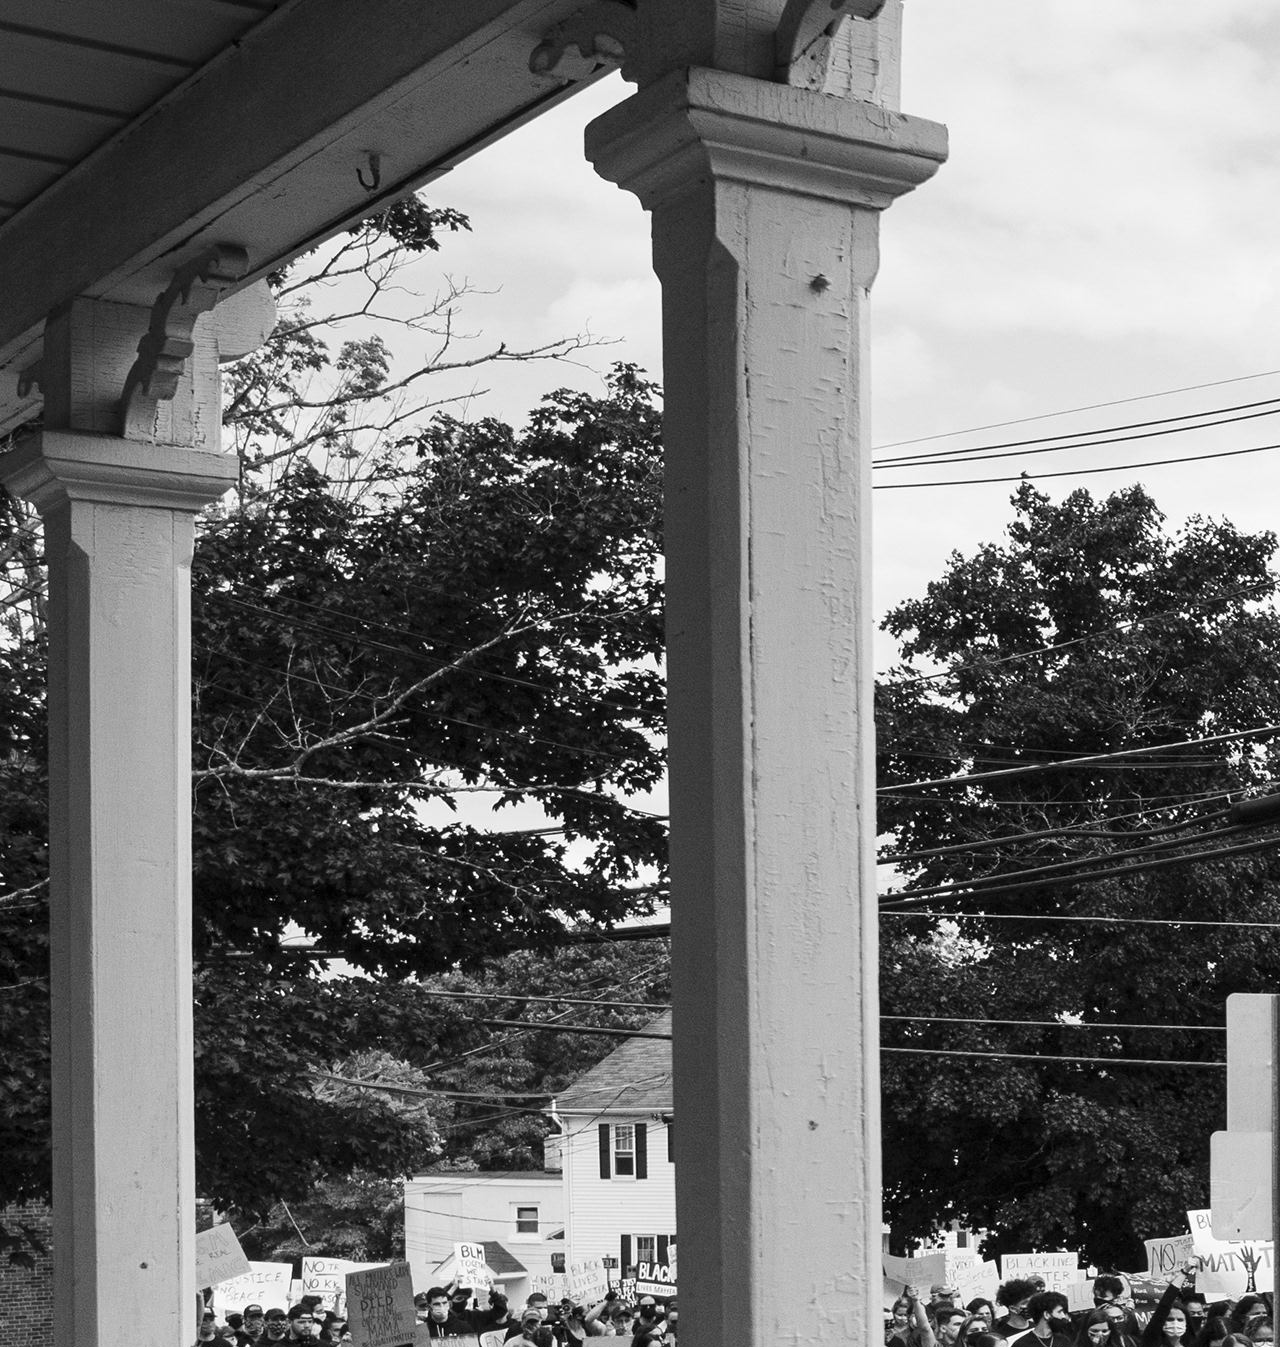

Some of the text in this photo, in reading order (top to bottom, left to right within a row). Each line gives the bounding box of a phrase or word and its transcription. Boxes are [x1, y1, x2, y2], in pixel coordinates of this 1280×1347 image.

[460, 1245, 484, 1260] BLM
[304, 1260, 325, 1273] NO
[570, 1260, 601, 1276] BLACK
[1006, 1257, 1076, 1270] BLACK LIVES
[573, 1273, 599, 1289] LIVES
[957, 1267, 994, 1288] Silence
[303, 1279, 319, 1291] NO
[972, 1285, 985, 1297] IS
[225, 1291, 266, 1304] PEACE
[360, 1295, 394, 1311] DIED
